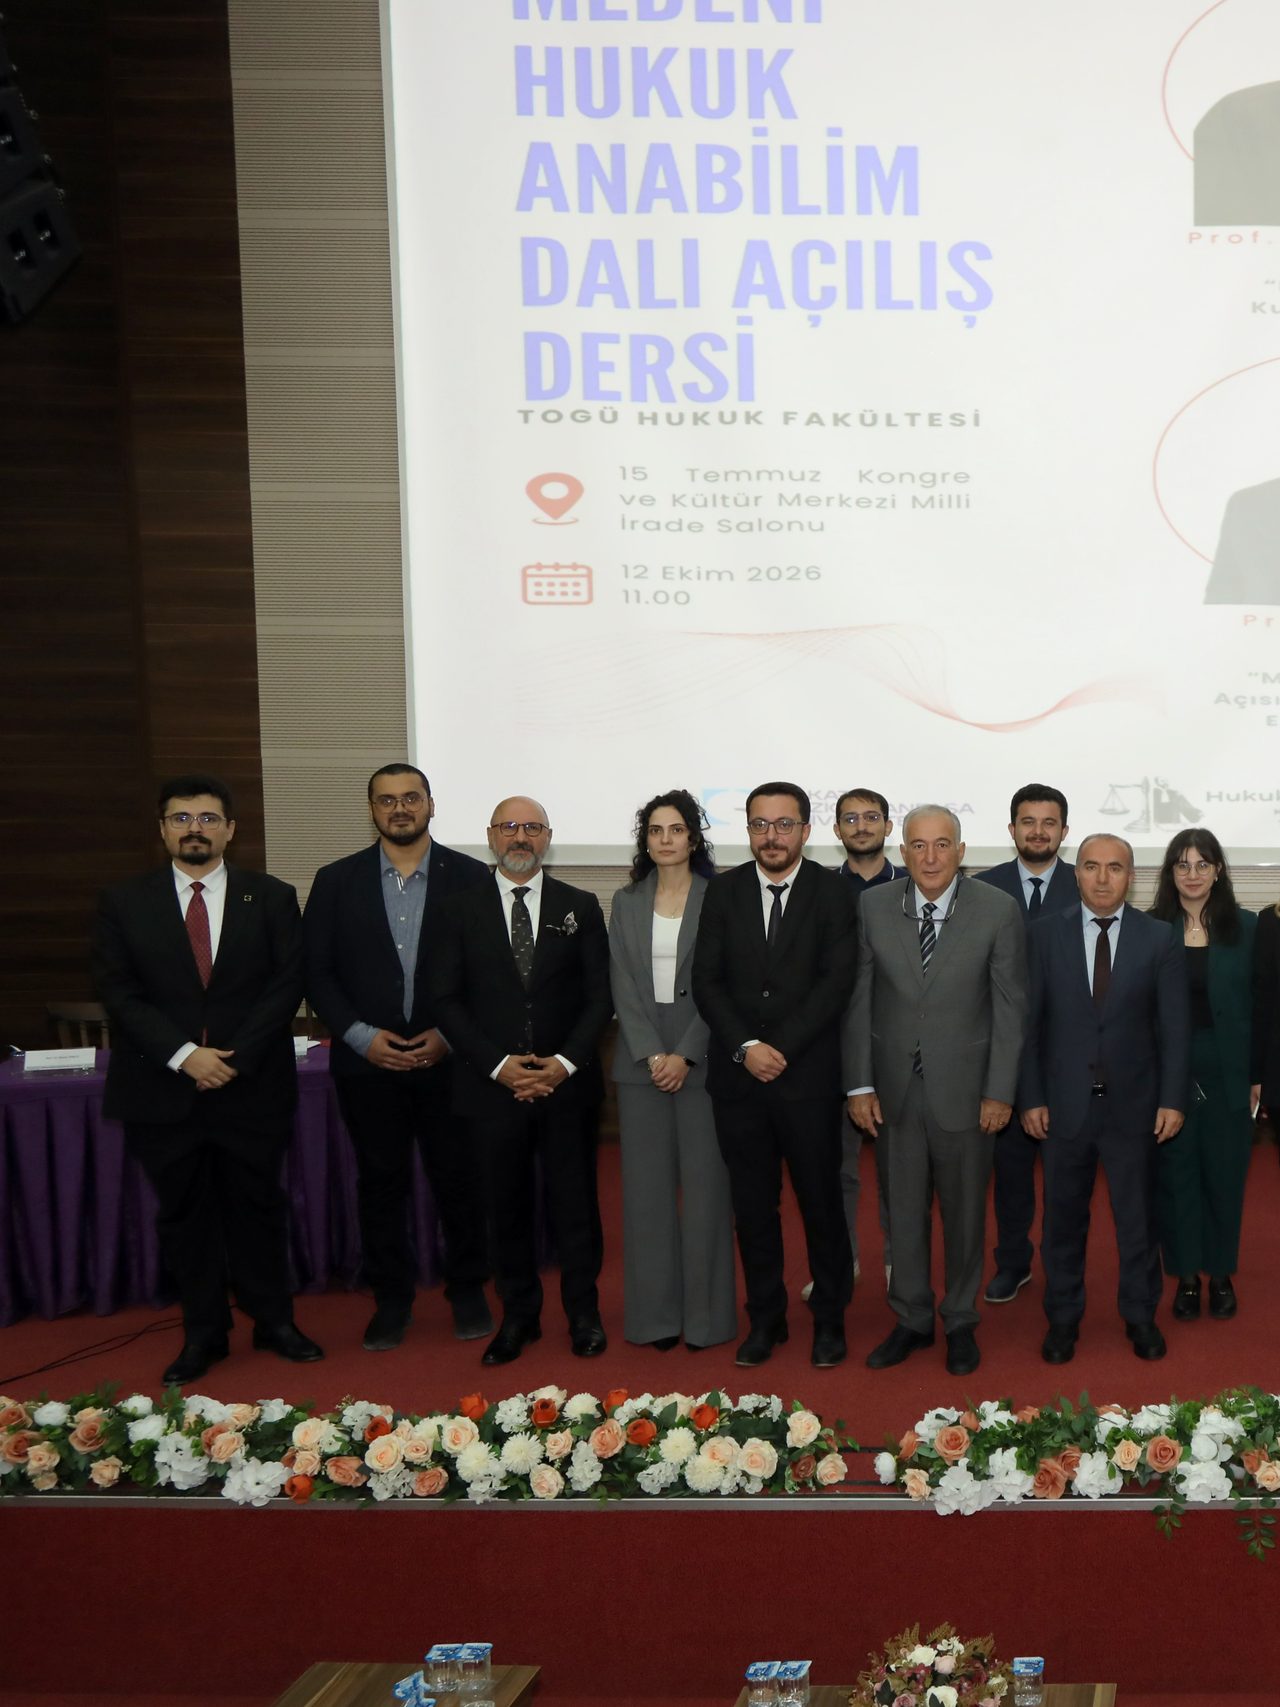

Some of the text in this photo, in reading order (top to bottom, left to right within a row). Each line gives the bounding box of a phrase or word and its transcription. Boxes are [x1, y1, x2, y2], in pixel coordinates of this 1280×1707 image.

[513, 44, 800, 121] HUKUK
[514, 126, 920, 217] ANABİLİM
[1187, 230, 1274, 247] Prof.
[519, 236, 995, 329] DALI AÇILIŞ
[522, 315, 756, 403] DERSİ
[517, 406, 983, 429] TOGÜ HUKUK FAKÜLTESİ
[618, 465, 972, 489] 15 Temmuz Kongre
[619, 491, 971, 511] ve Kültür Merkezi Milli
[620, 513, 826, 534] İrade Salonu
[621, 563, 822, 582] 12 Ekim 2026
[621, 589, 692, 607] 11.00
